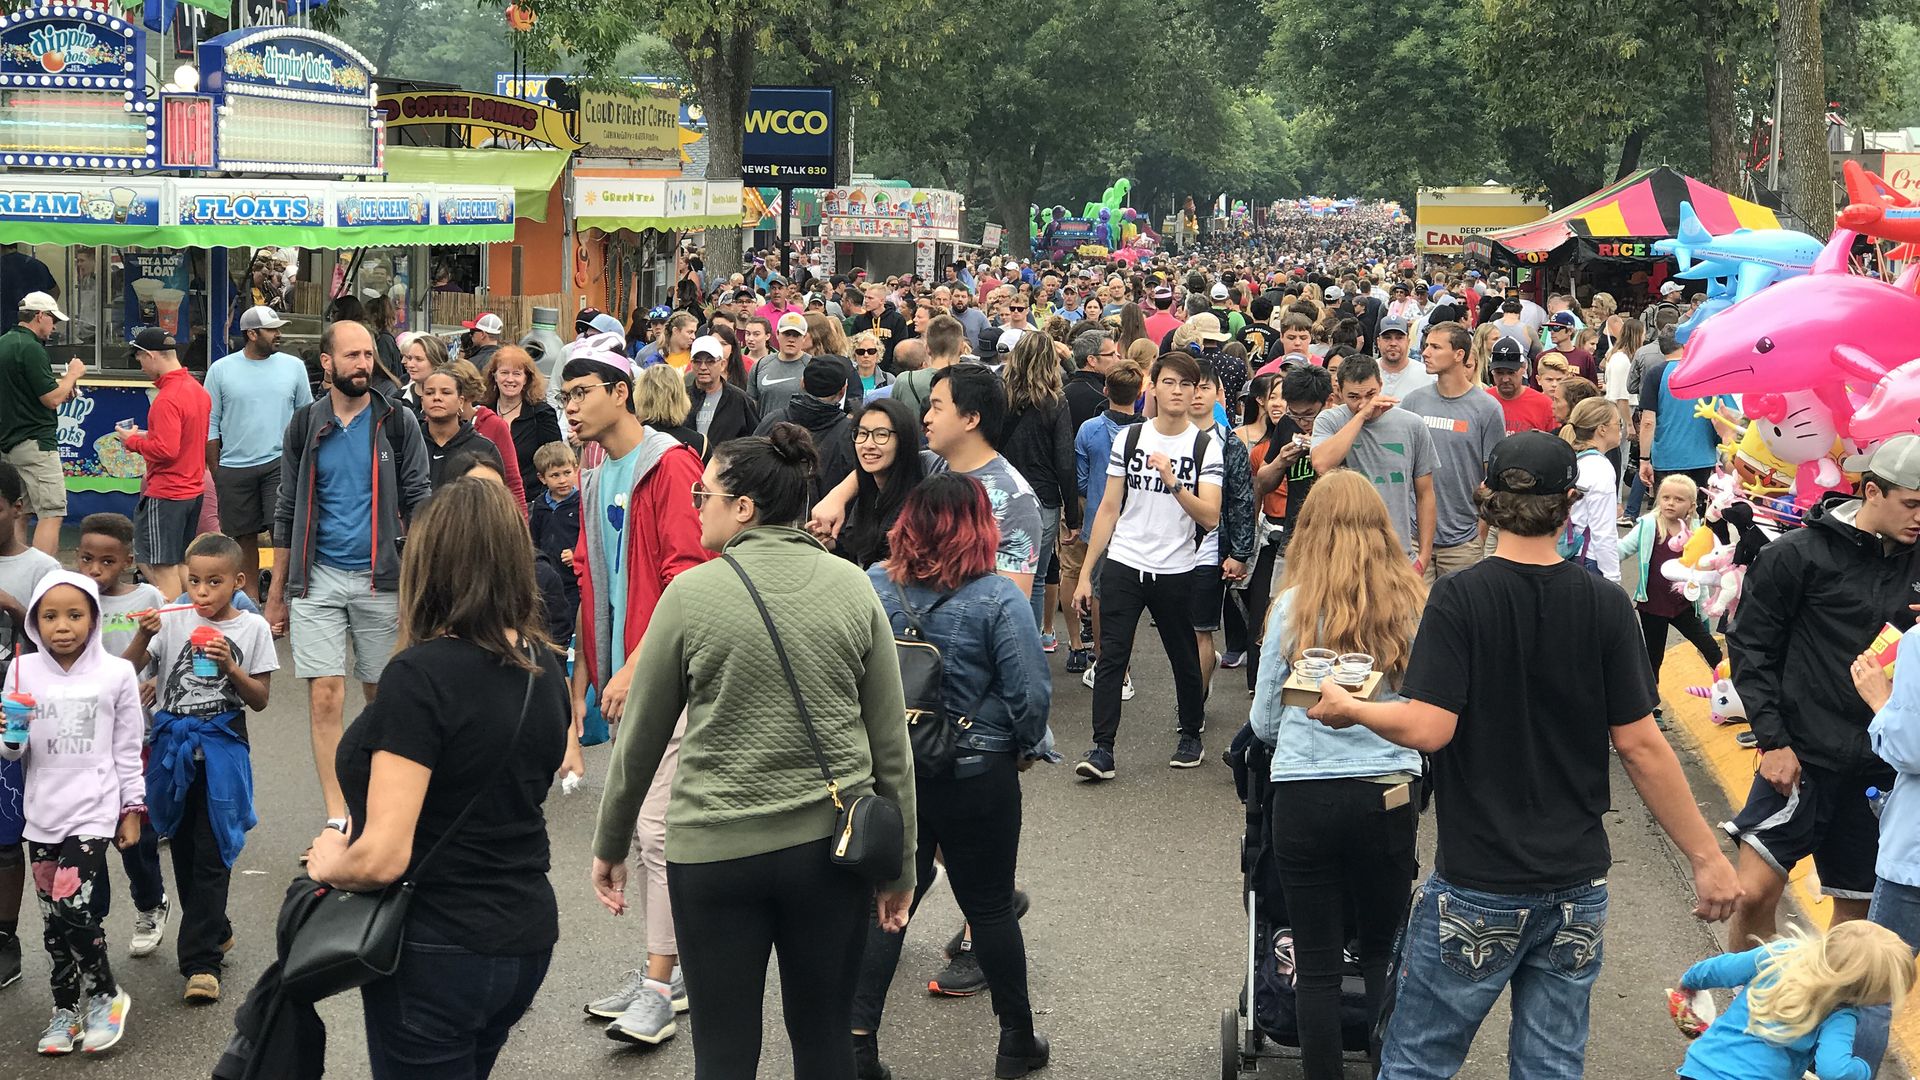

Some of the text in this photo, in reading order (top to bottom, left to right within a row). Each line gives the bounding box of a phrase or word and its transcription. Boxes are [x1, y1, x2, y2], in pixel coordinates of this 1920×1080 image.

[64, 48, 89, 65] dots
[306, 51, 332, 83] dots
[402, 95, 470, 118] COFFEE
[471, 97, 538, 131] DRINKS
[585, 99, 676, 128] CLOUD FOREST COFFEE
[744, 110, 828, 135] WCCO
[742, 165, 827, 175] NEWS TALK 830
[196, 197, 308, 219] FLOATS
[360, 199, 409, 218] ICE CREAM
[457, 200, 497, 218] ICE CREAM
[1516, 251, 1549, 264] POP
[1598, 243, 1646, 257] RICE
[138, 256, 179, 266] TRY A DOT
[142, 265, 175, 277] FLOAT
[1423, 415, 1455, 431] PUMA
